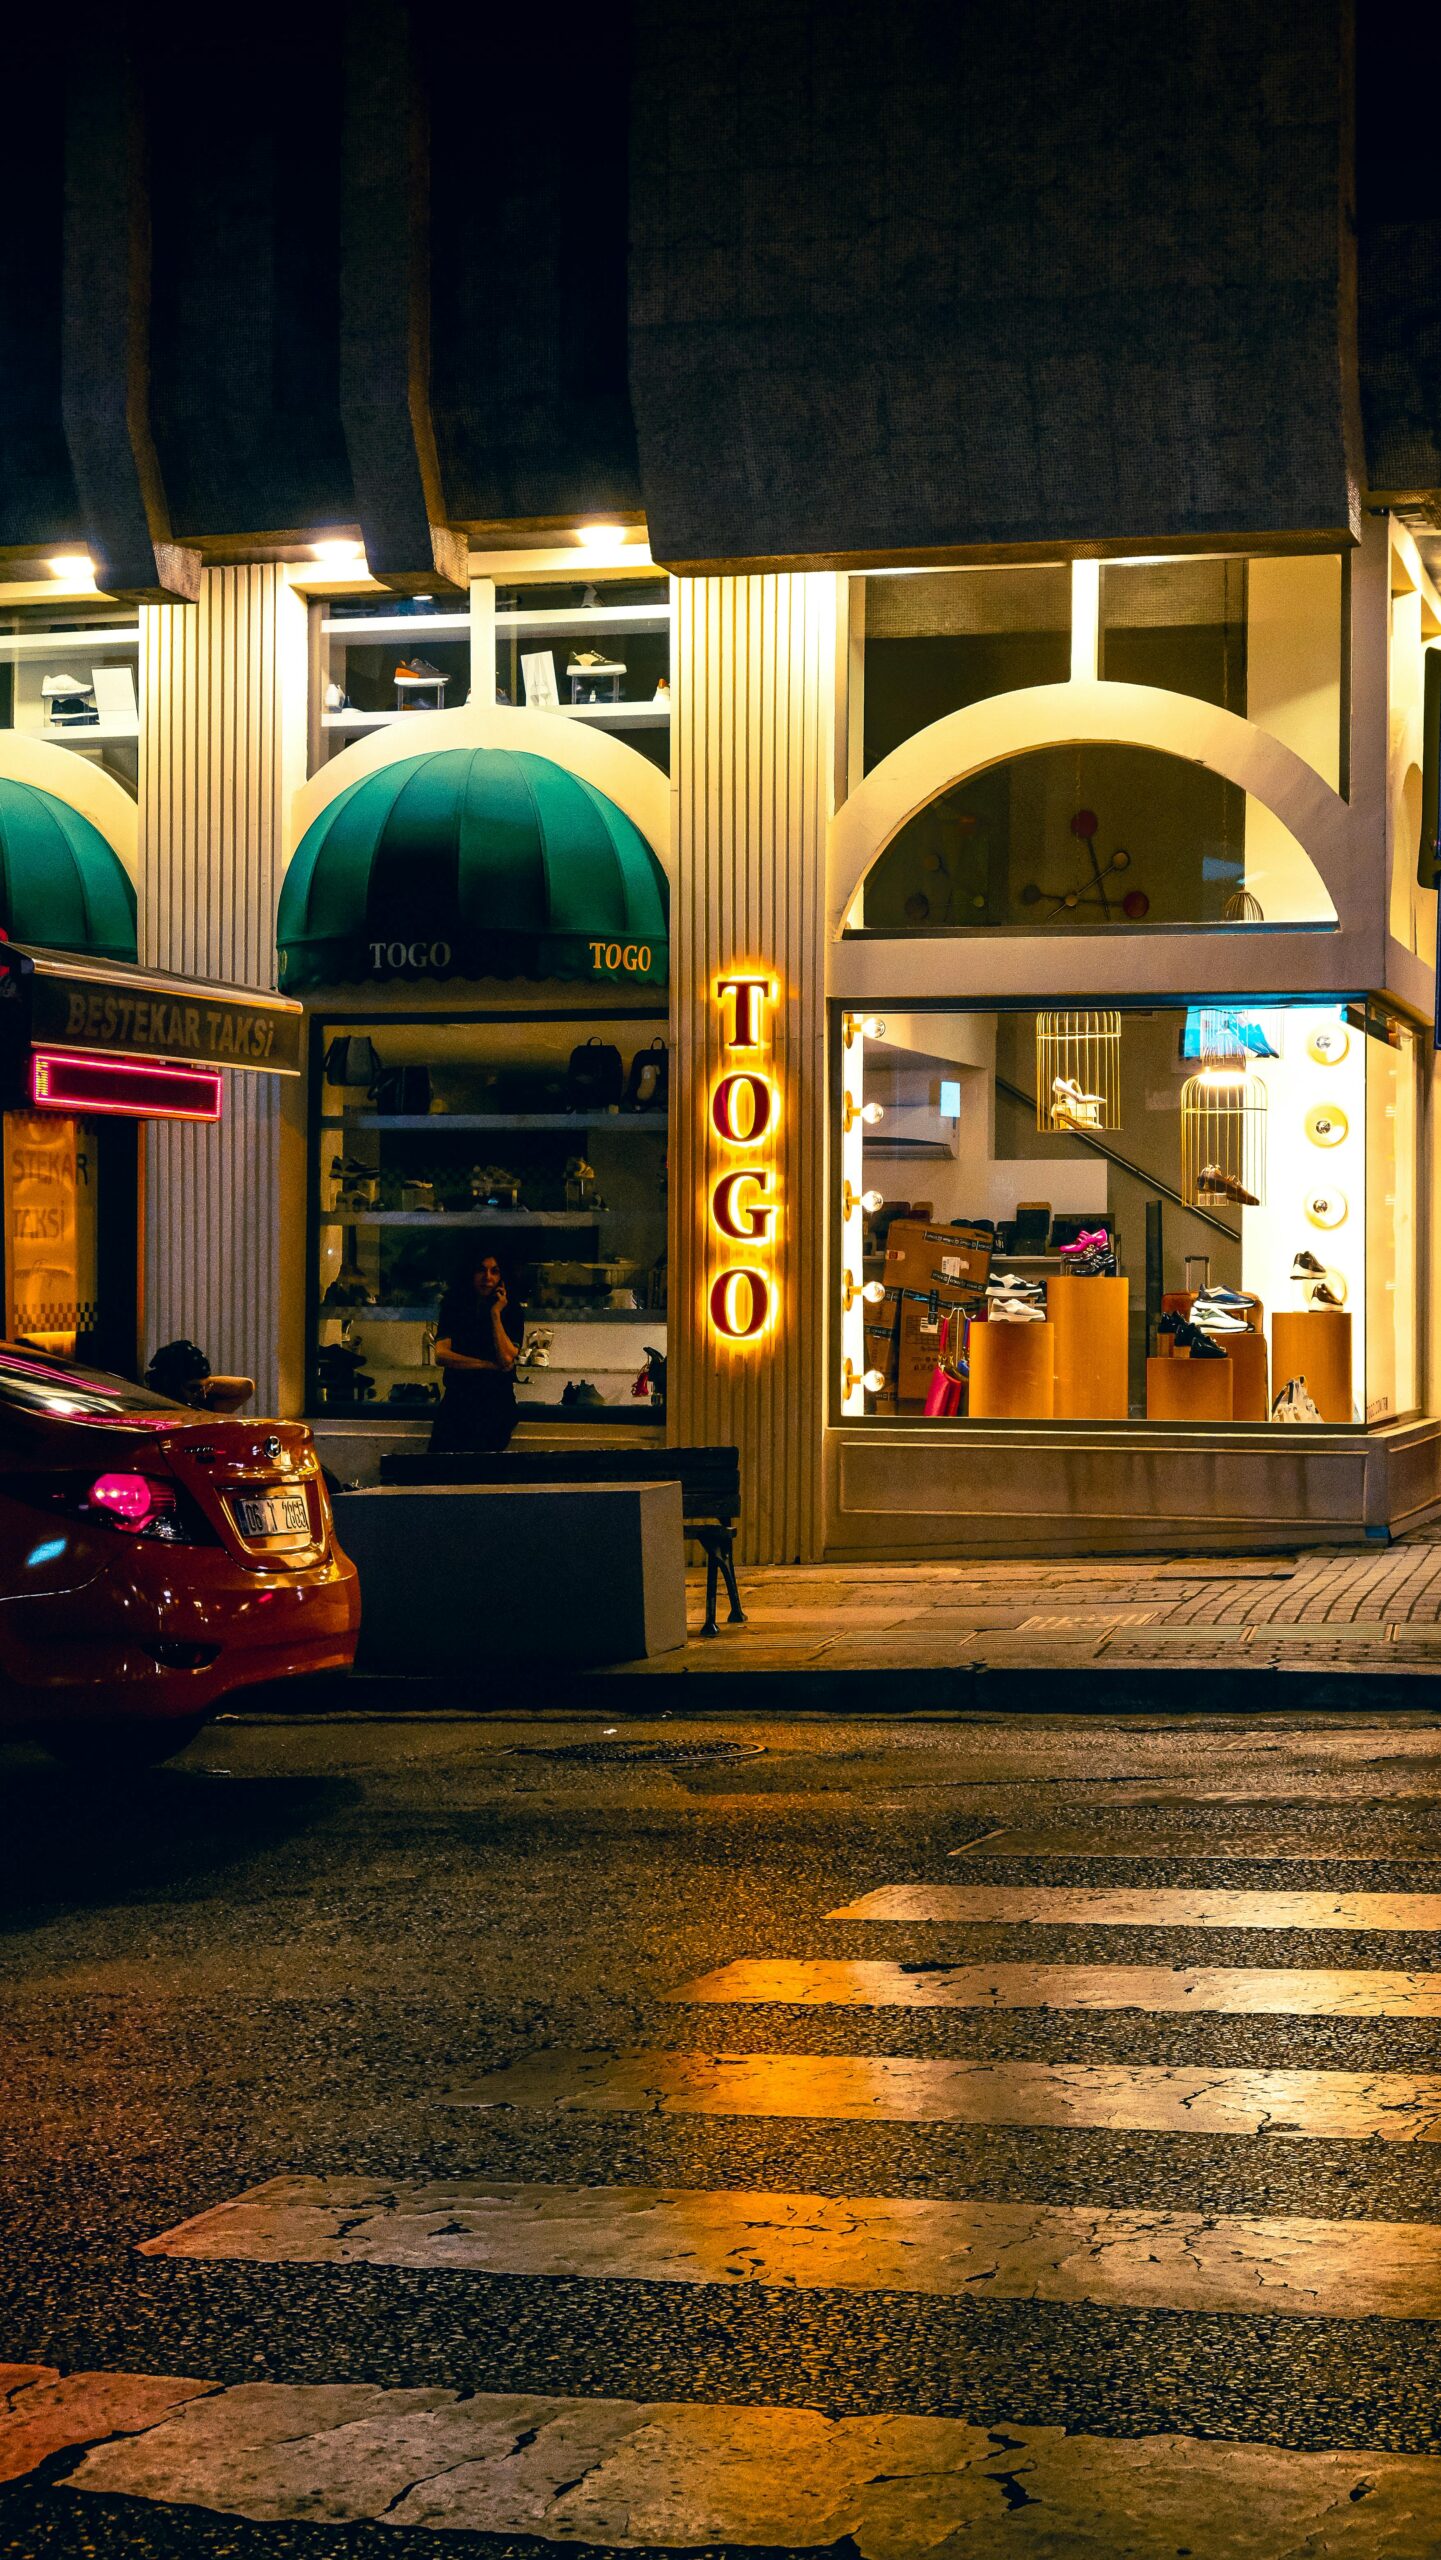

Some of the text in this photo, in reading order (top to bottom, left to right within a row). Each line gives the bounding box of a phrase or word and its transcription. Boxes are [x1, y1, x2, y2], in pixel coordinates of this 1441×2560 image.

[369, 942, 452, 969] TOGO
[589, 942, 652, 972] TOGO
[66, 994, 201, 1047] BESTEKAR
[709, 980, 772, 1338] TOGO
[245, 1503, 263, 1531] 06
